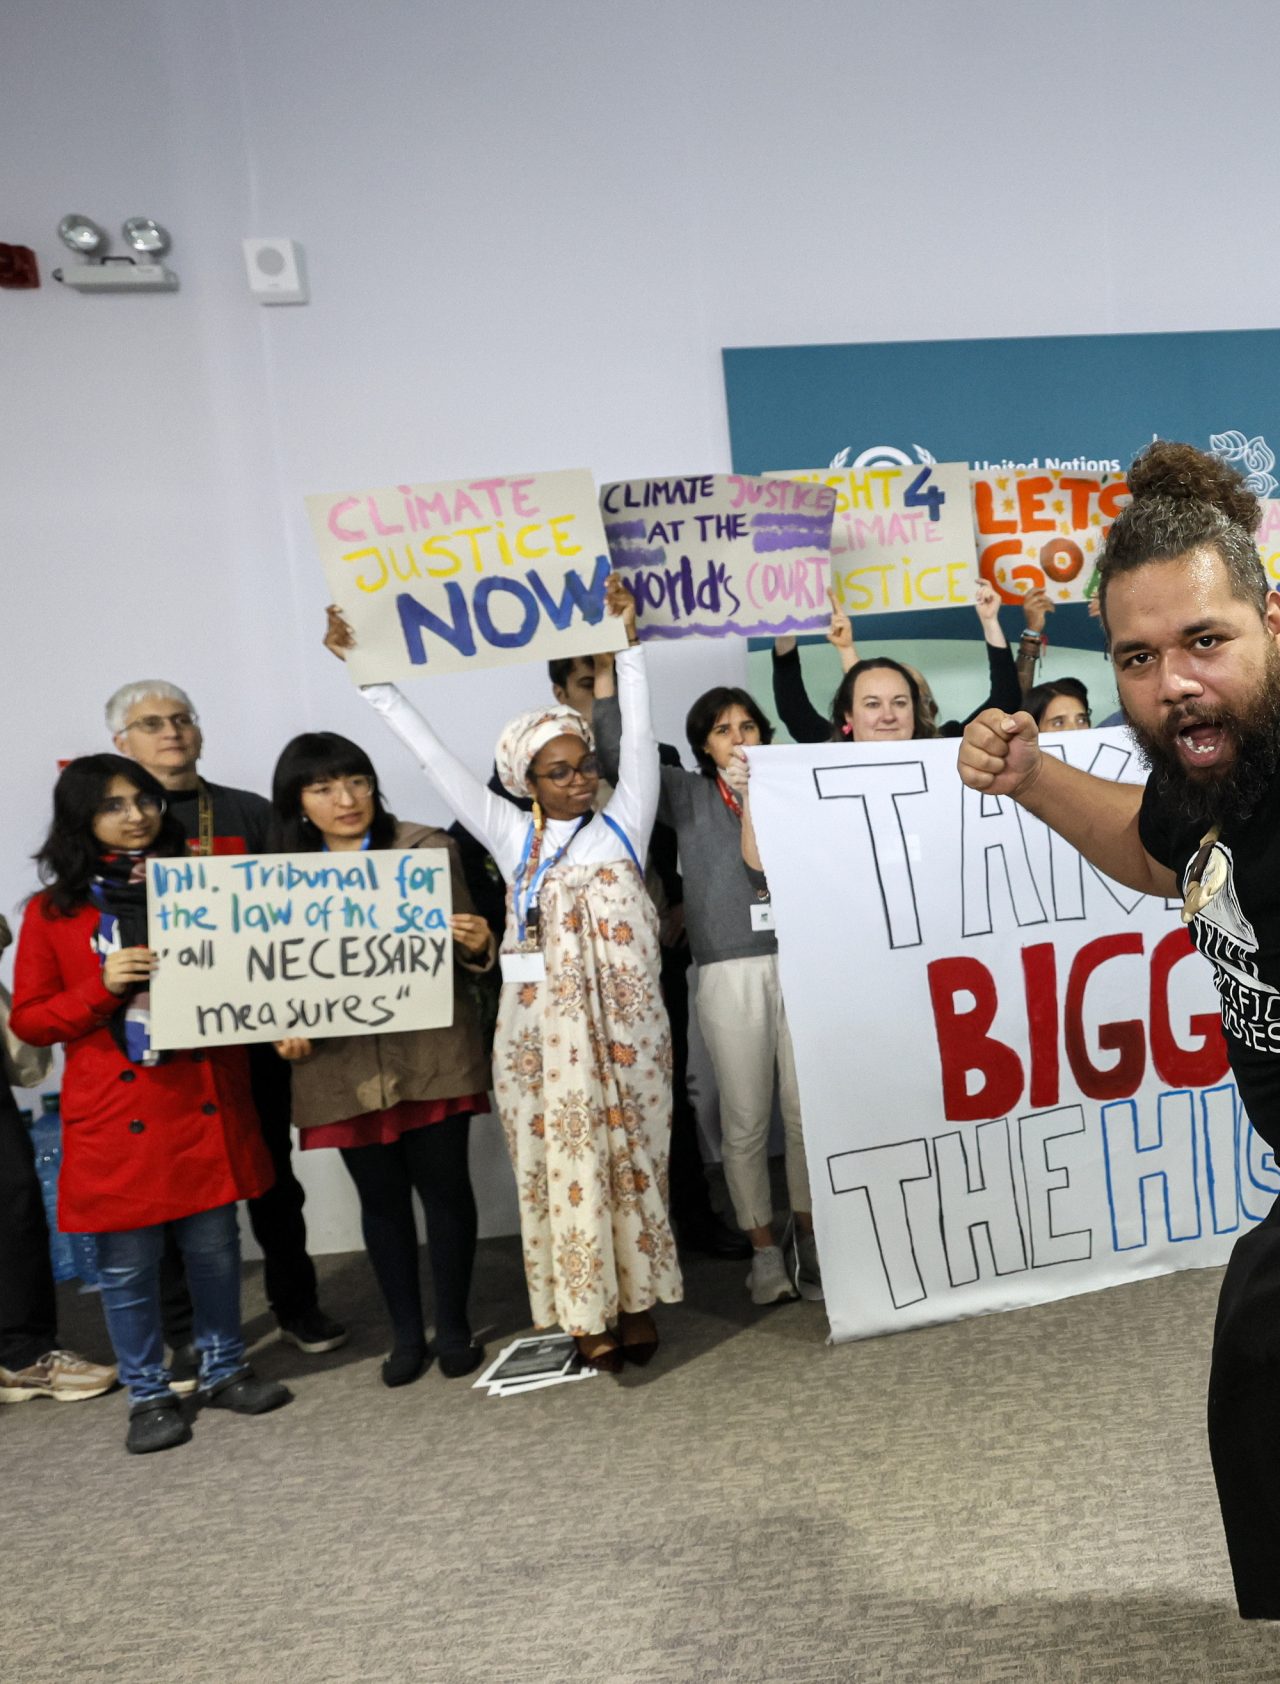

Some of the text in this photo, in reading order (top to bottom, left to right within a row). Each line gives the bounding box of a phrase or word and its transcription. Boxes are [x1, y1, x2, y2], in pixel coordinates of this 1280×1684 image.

[1045, 456, 1121, 472] Nations
[604, 474, 834, 514] CLIMATE JUSTICE
[904, 466, 946, 522] 4
[648, 512, 749, 544] AT THE
[746, 556, 830, 609] COURT
[979, 538, 1085, 606] GO
[395, 555, 612, 666] NOW
[231, 857, 379, 892] Tribunal
[395, 855, 444, 899] for
[156, 902, 217, 931] the
[231, 893, 292, 934] law
[305, 895, 335, 932] of
[394, 902, 447, 934] sea
[247, 933, 447, 982] NECESSARY
[826, 1104, 1093, 1310] THE
